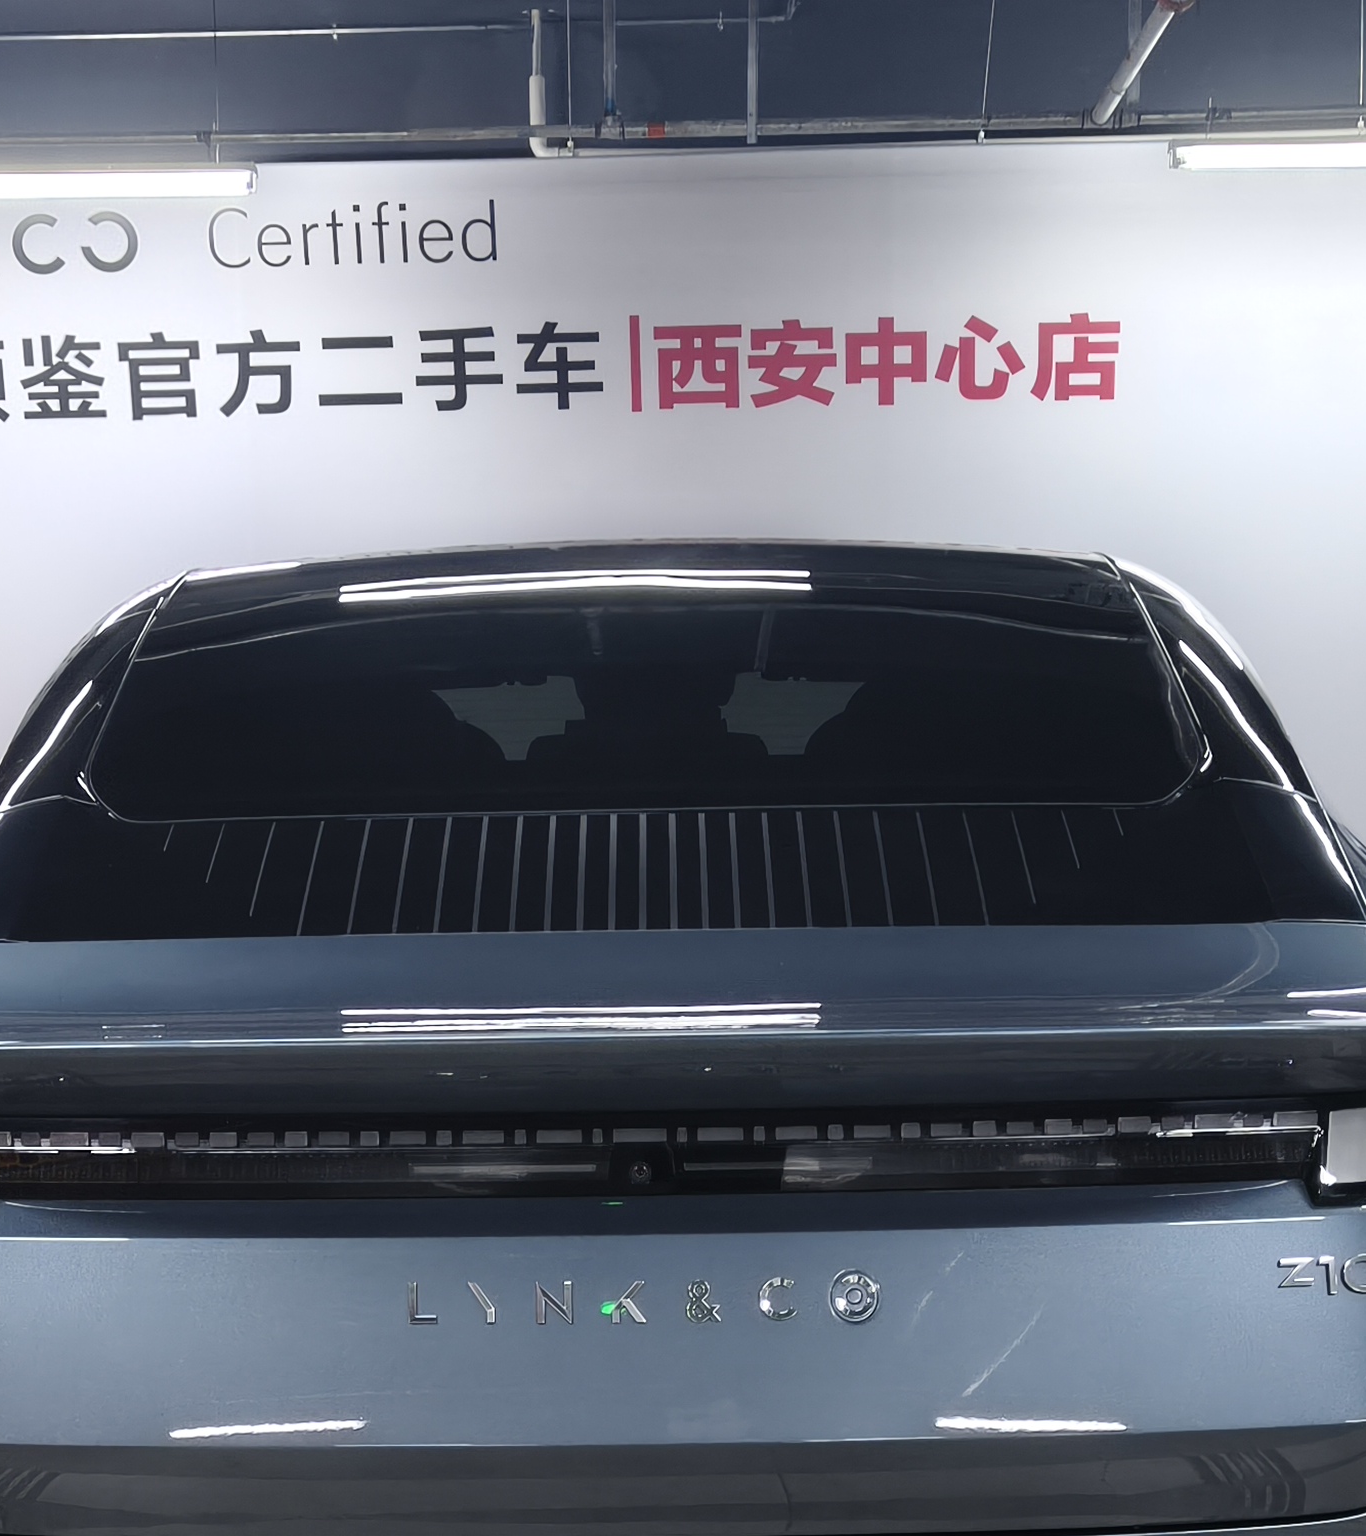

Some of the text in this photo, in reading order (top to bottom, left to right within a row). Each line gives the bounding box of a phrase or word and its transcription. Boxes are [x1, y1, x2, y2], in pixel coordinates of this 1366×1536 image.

[207, 199, 499, 270] Certified
[651, 312, 1121, 409] 西安中心店
